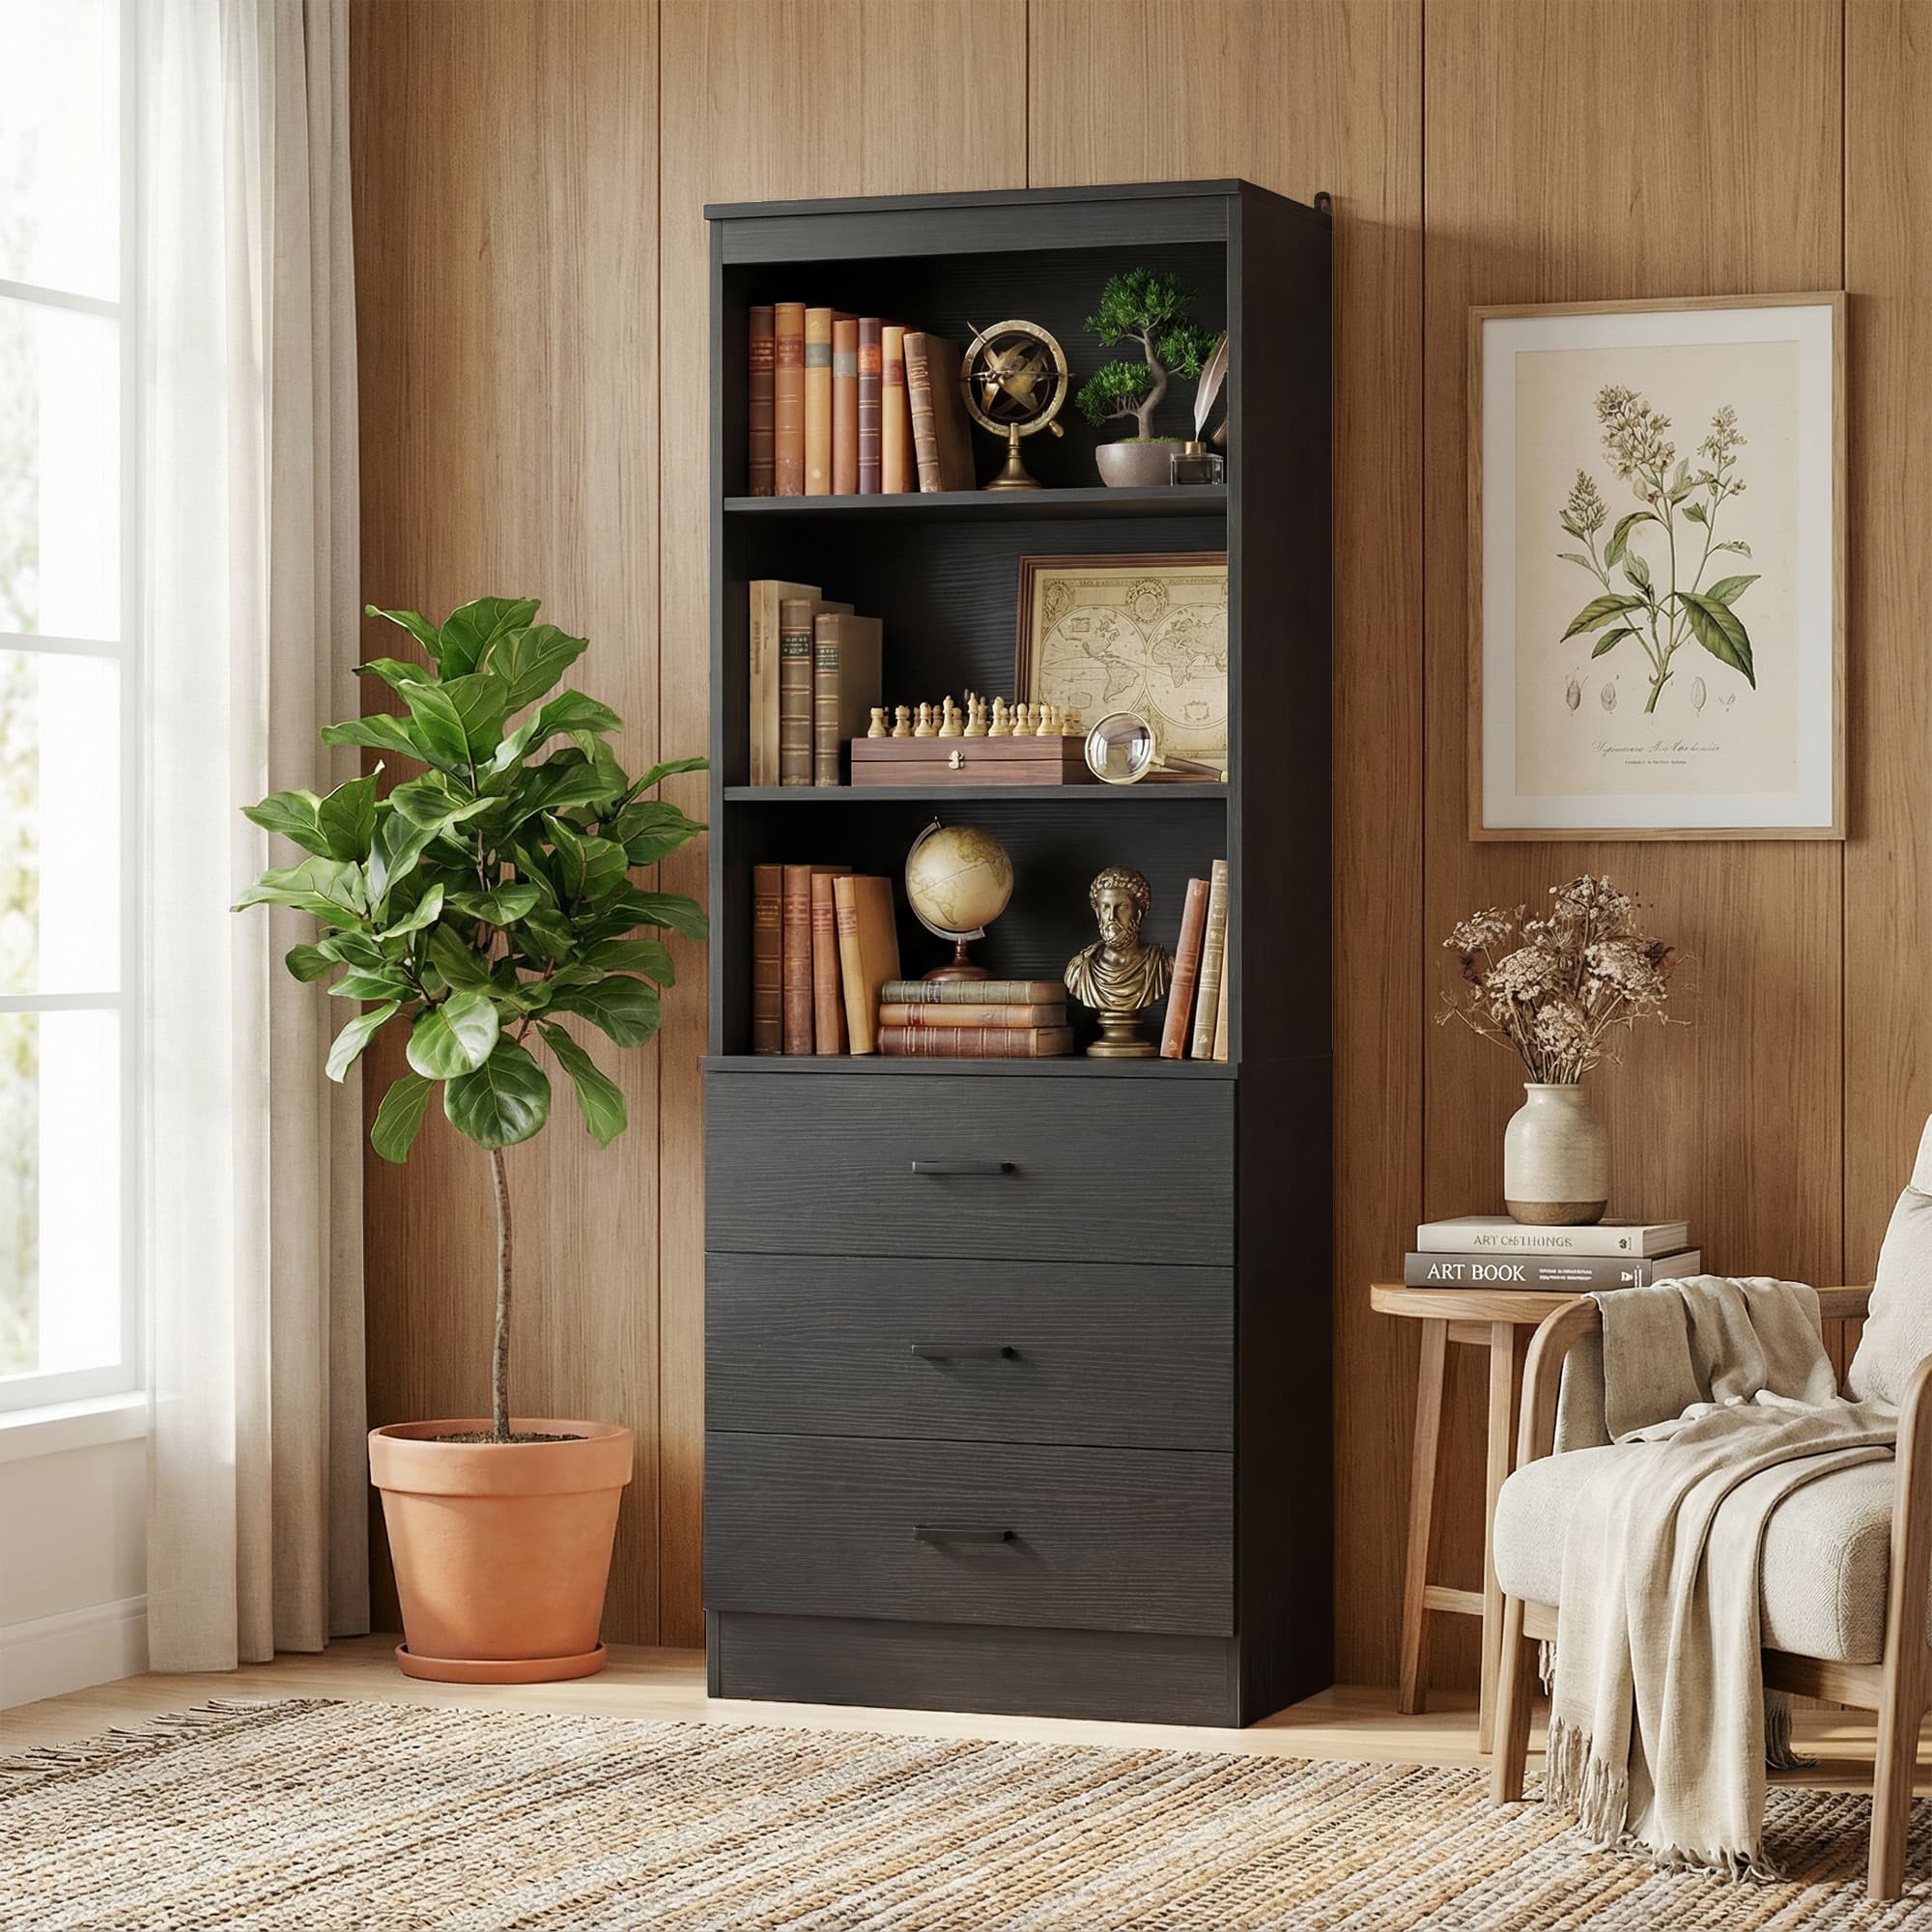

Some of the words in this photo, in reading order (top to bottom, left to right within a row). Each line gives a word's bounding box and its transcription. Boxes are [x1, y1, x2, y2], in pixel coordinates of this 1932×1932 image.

[1473, 1235, 1497, 1246] ART
[1427, 1263, 1465, 1281] ART
[1471, 1264, 1526, 1282] BOOK
